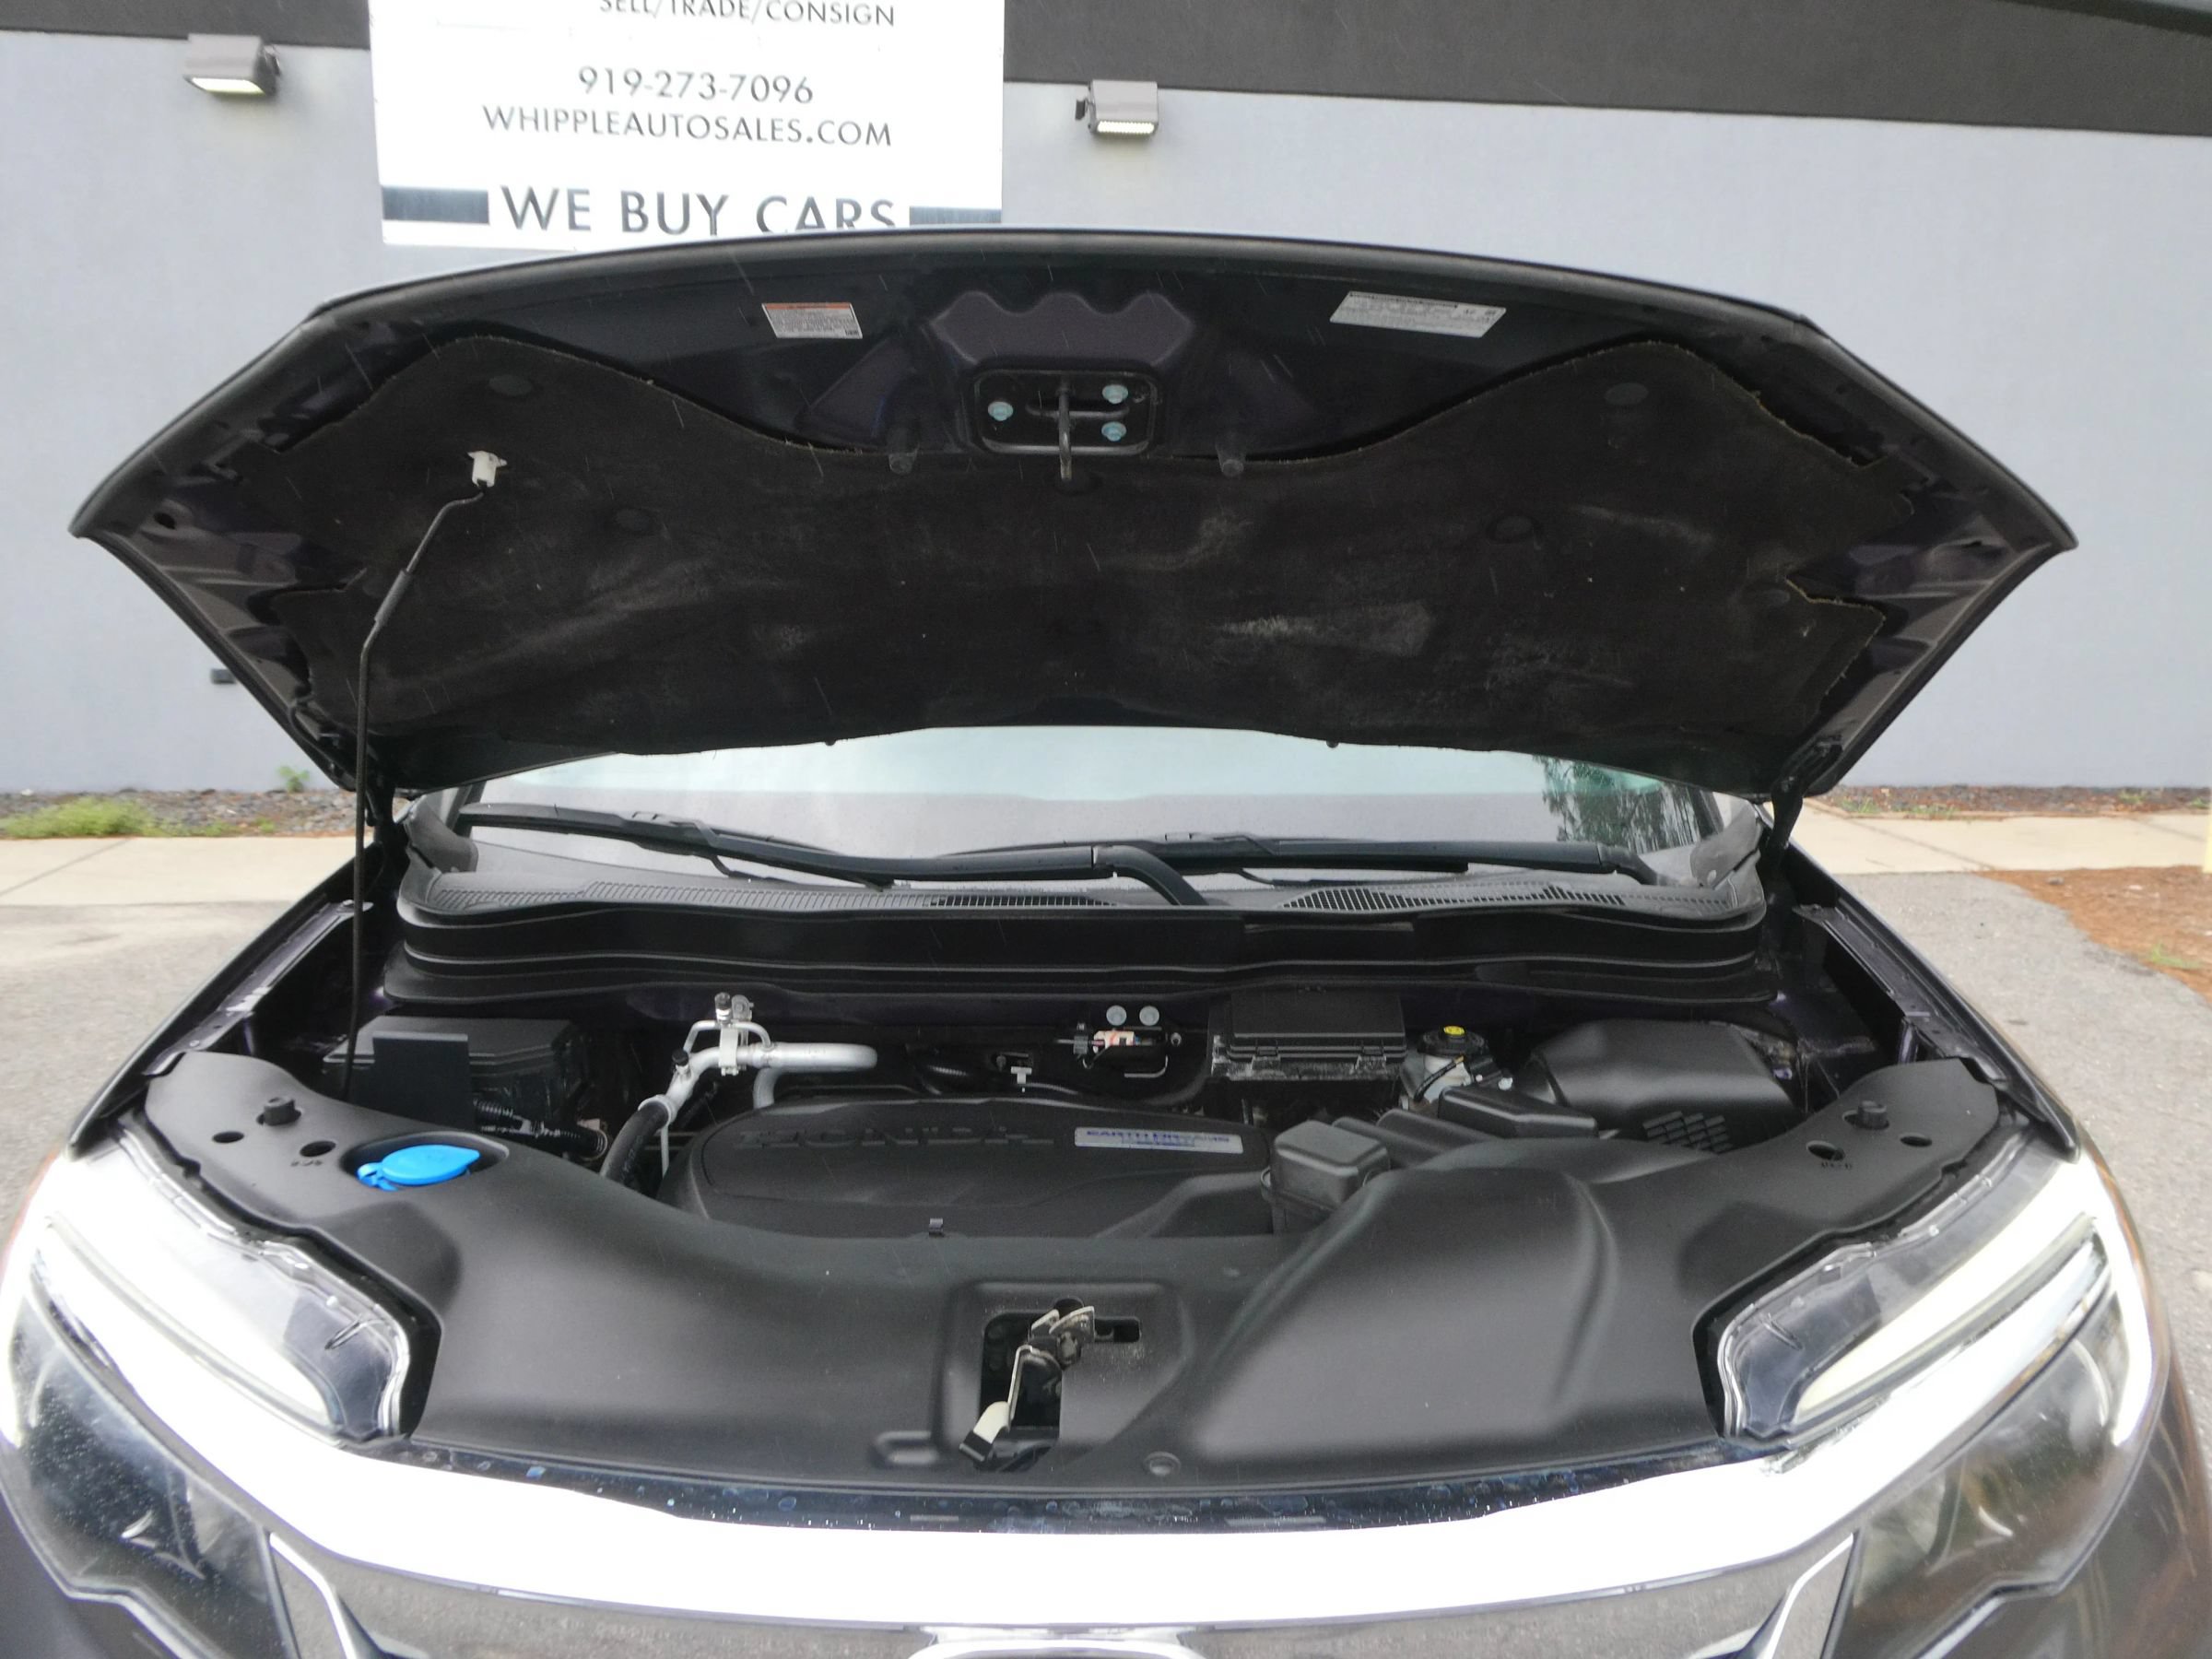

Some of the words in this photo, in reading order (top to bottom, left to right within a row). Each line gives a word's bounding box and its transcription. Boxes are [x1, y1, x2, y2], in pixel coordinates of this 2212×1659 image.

[578, 65, 814, 104] 919-273-7096
[482, 104, 892, 147] WHIPPLEAUTOSALES.COM
[500, 185, 592, 231] WE
[620, 190, 729, 237] BUY
[755, 194, 896, 234] CARS
